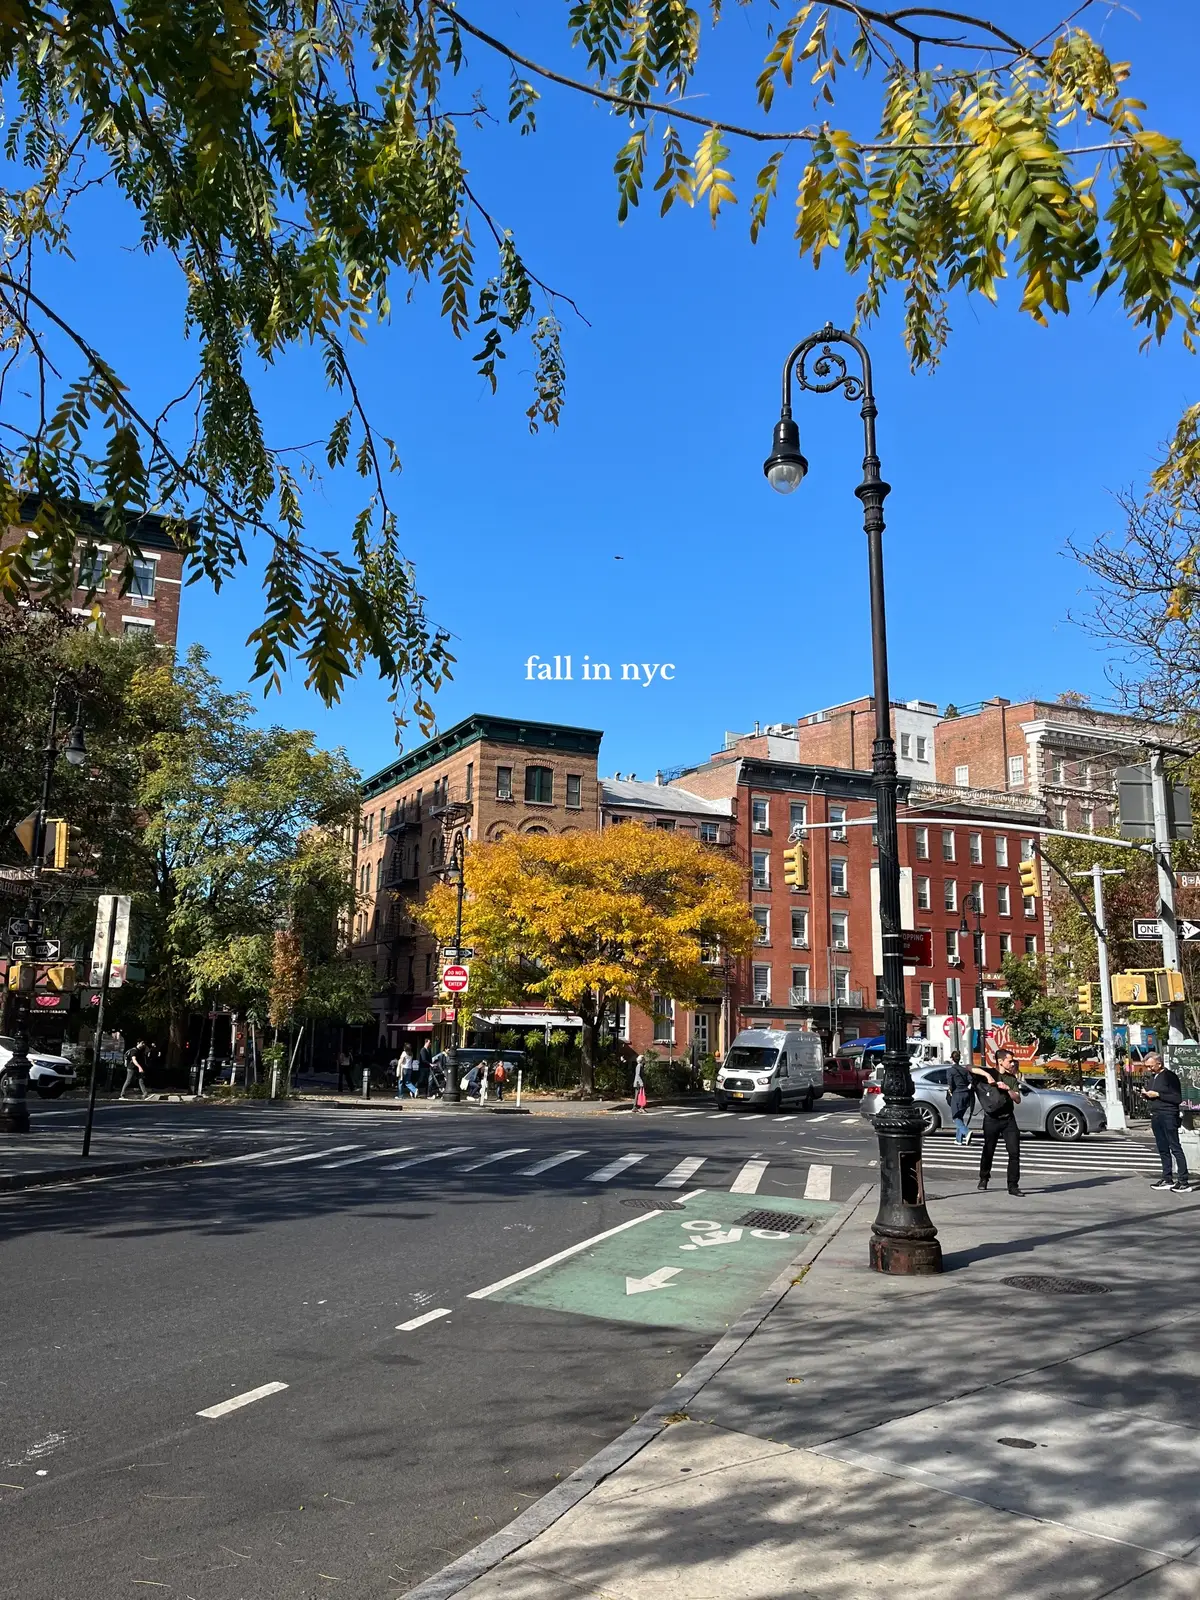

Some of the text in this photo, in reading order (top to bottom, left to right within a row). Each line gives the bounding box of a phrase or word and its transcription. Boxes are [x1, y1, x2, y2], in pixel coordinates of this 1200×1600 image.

[1181, 875, 1188, 887] 8
[1139, 925, 1160, 934] ONE
[902, 933, 924, 941] OPPING
